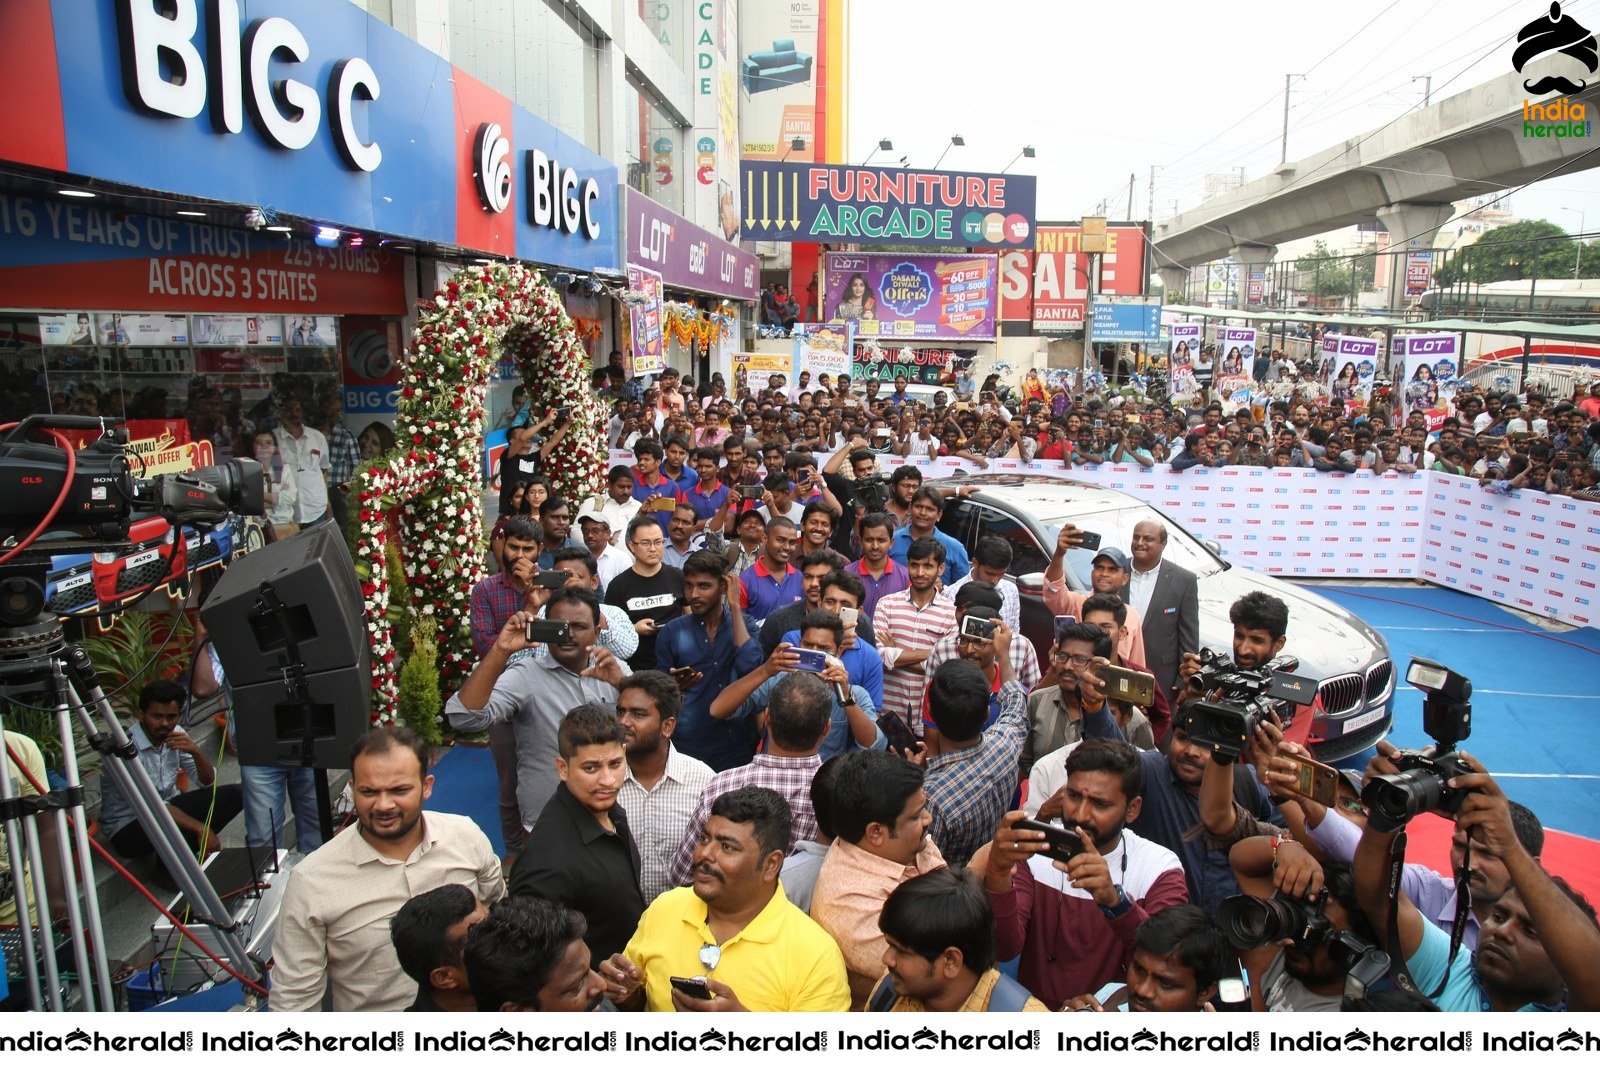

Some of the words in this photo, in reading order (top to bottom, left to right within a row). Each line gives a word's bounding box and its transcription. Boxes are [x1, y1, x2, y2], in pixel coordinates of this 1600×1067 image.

[118, 0, 321, 150] BIG
[328, 57, 383, 172] C
[808, 168, 1006, 208] FURNITURE
[527, 149, 580, 234] BIG
[581, 178, 601, 241] C
[809, 204, 953, 240] ARCADE
[44, 202, 140, 249] YEARS
[147, 216, 180, 251] OF
[185, 221, 252, 260] TRUST
[149, 258, 236, 298] ACROSS
[241, 268, 252, 299] 3
[256, 268, 317, 302] STATES
[890, 274, 922, 282] DASARA
[950, 271, 965, 284] 60
[1002, 252, 1117, 300] SALE
[1035, 308, 1080, 319] BANTIA
[1229, 331, 1250, 339] LOT
[1343, 344, 1370, 353] LOT
[1412, 340, 1446, 352] LOT
[346, 391, 381, 408] BIG
[157, 450, 181, 465] OFFER
[133, 553, 153, 564] ALTO
[64, 577, 84, 588] ALTO
[635, 597, 665, 608] CREATE
[1418, 756, 1434, 765] Canon
